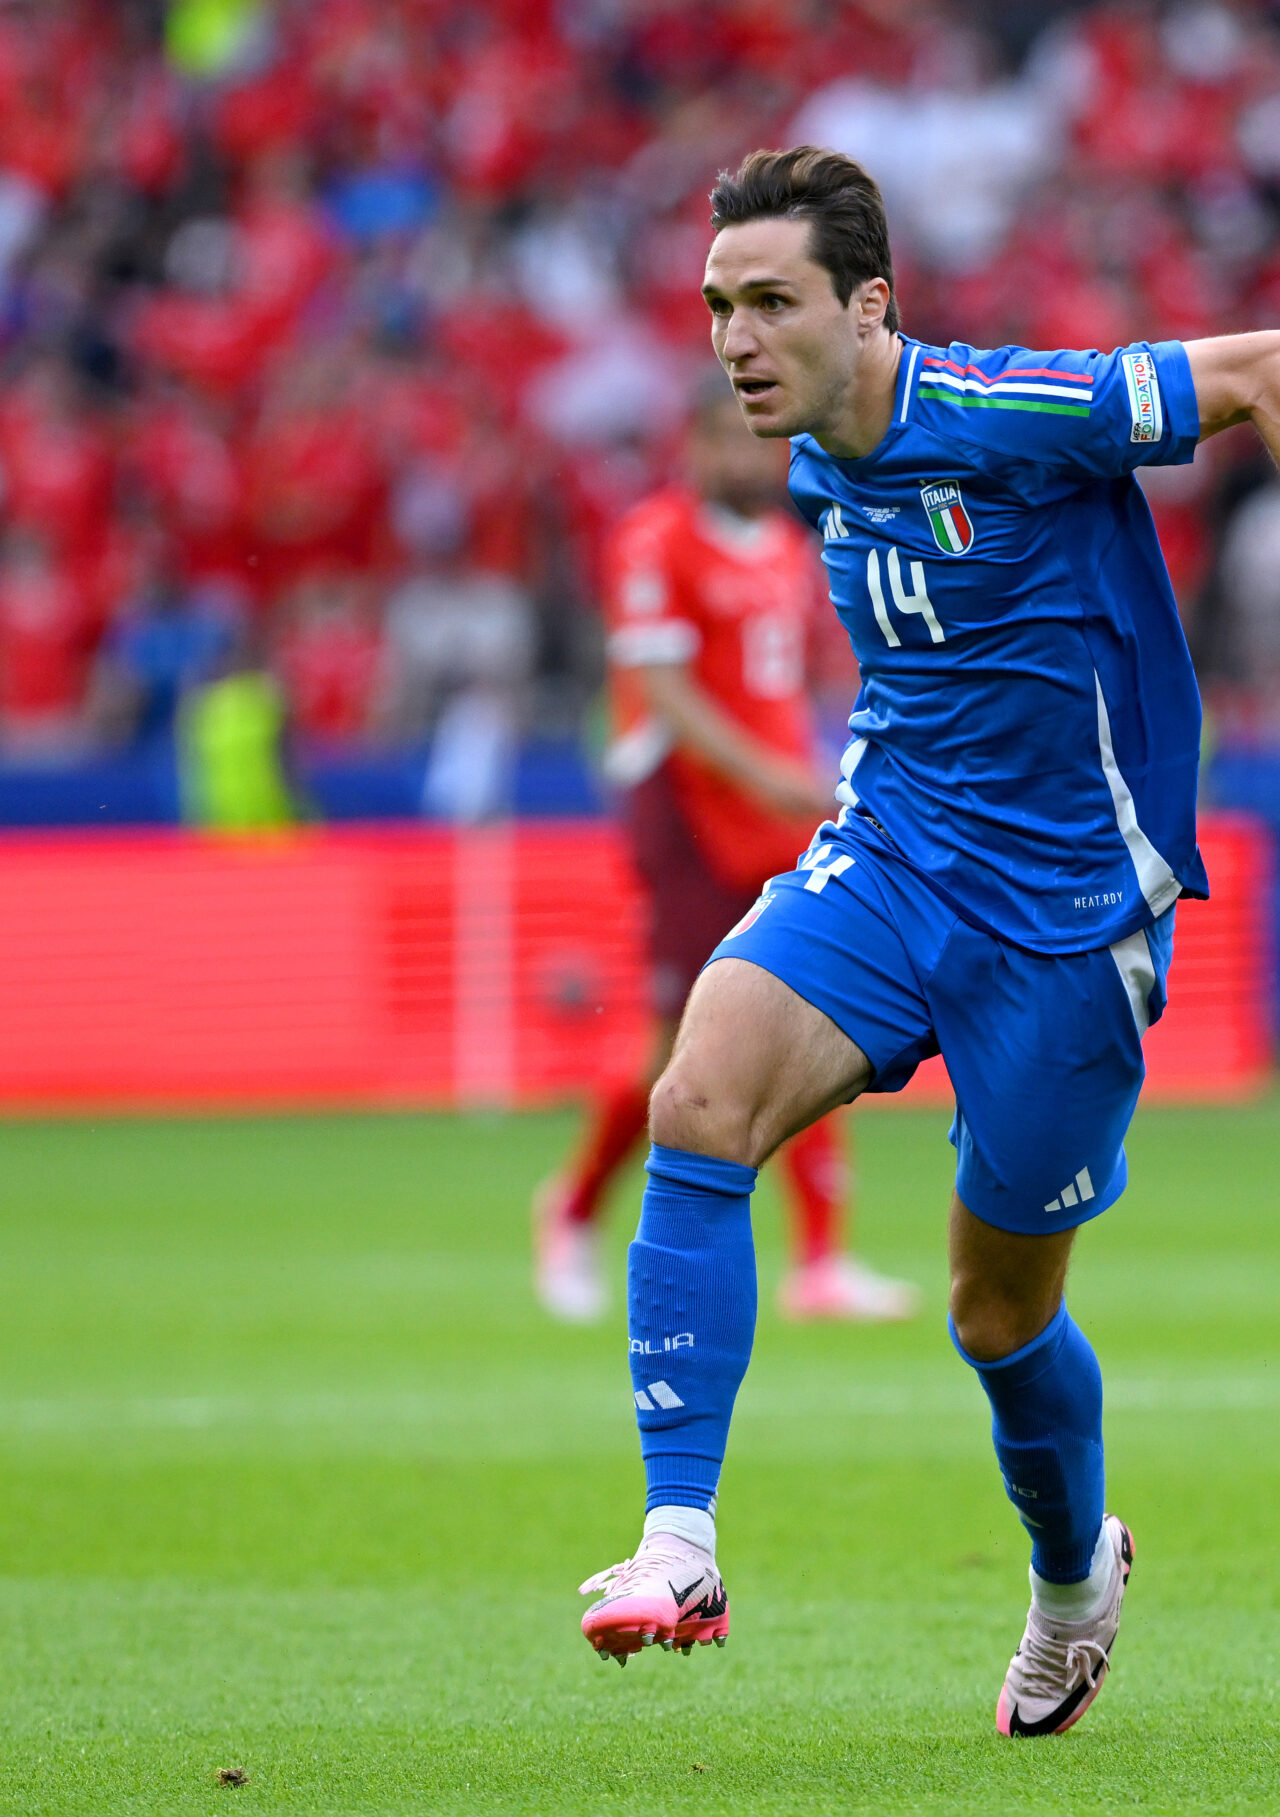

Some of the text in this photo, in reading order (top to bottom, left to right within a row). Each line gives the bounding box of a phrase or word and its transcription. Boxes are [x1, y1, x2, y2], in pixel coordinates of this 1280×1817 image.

[1132, 355, 1152, 440] FOUNDATION
[1132, 422, 1141, 440] UEFA
[924, 484, 957, 507] ITALIA
[867, 546, 946, 647] 14
[1074, 891, 1122, 909] HEAT.RDY
[628, 1332, 694, 1355] ALIA
